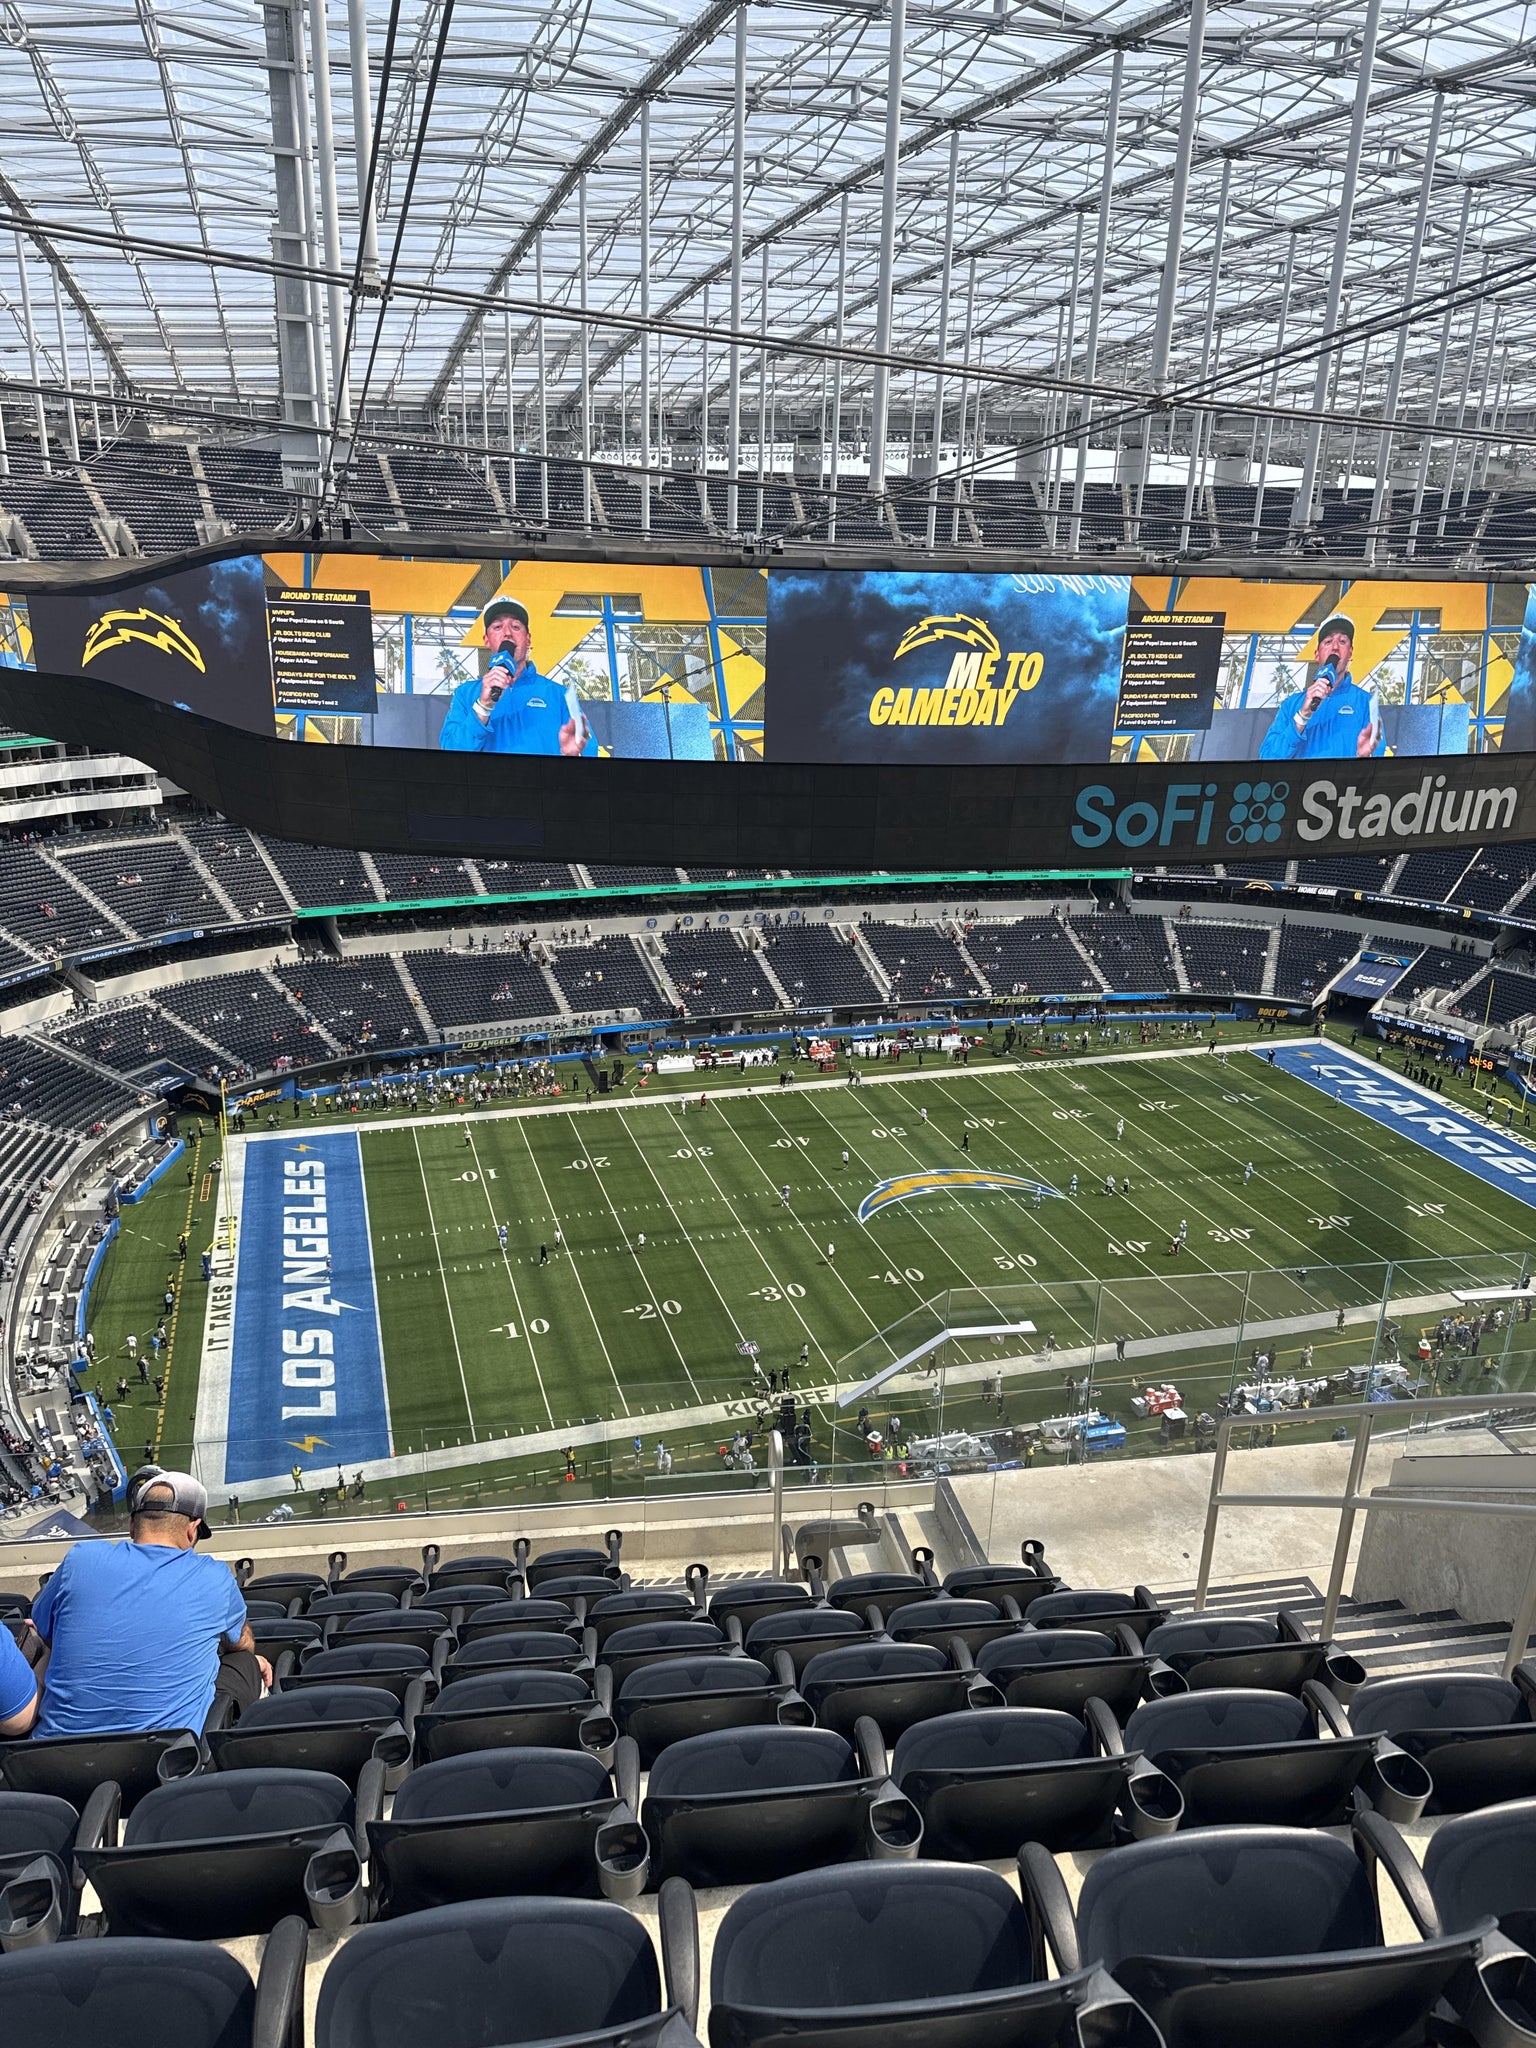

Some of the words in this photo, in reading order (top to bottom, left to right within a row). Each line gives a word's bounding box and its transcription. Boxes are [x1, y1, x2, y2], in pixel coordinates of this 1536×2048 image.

[280, 592, 310, 600] AROUND
[311, 593, 324, 601] THE
[324, 594, 356, 602] STADIUM
[1141, 615, 1170, 623] AROUND
[1171, 615, 1183, 623] THE
[1183, 615, 1214, 624] STADIUM
[944, 651, 1001, 690] ME
[1005, 651, 1044, 690] TO
[868, 687, 1019, 726] GAMEDAY
[1071, 783, 1217, 848] SoFi
[1297, 775, 1517, 842] Stadium
[1258, 1008, 1277, 1018] BOLT
[1277, 1009, 1288, 1018] UP
[1372, 1014, 1384, 1022] SoFi
[1397, 1020, 1409, 1028] SoFi
[481, 1037, 520, 1047] ANGELES
[547, 1029, 592, 1039] CHARGERS
[1402, 1034, 1445, 1050] ANGELES
[1447, 1034, 1459, 1042] SoFi
[1016, 1059, 1077, 1070] KICKOFF
[235, 1088, 282, 1107] CHARGERS
[1441, 1101, 1495, 1126] NEVER
[1310, 1064, 1536, 1185] CHARGE
[1404, 1202, 1443, 1218] 10
[1307, 1214, 1351, 1230] 20
[283, 1160, 354, 1316] ANGELES
[1207, 1227, 1252, 1243] 30
[1107, 1240, 1145, 1256] 40
[992, 1253, 1037, 1270] 50
[881, 1267, 925, 1285] 40
[761, 1283, 807, 1302] 30
[209, 1284, 232, 1331] TAKES
[634, 1299, 682, 1320] 20
[502, 1318, 550, 1339] 10
[207, 1337, 229, 1352] IT
[281, 1328, 337, 1421] LOS
